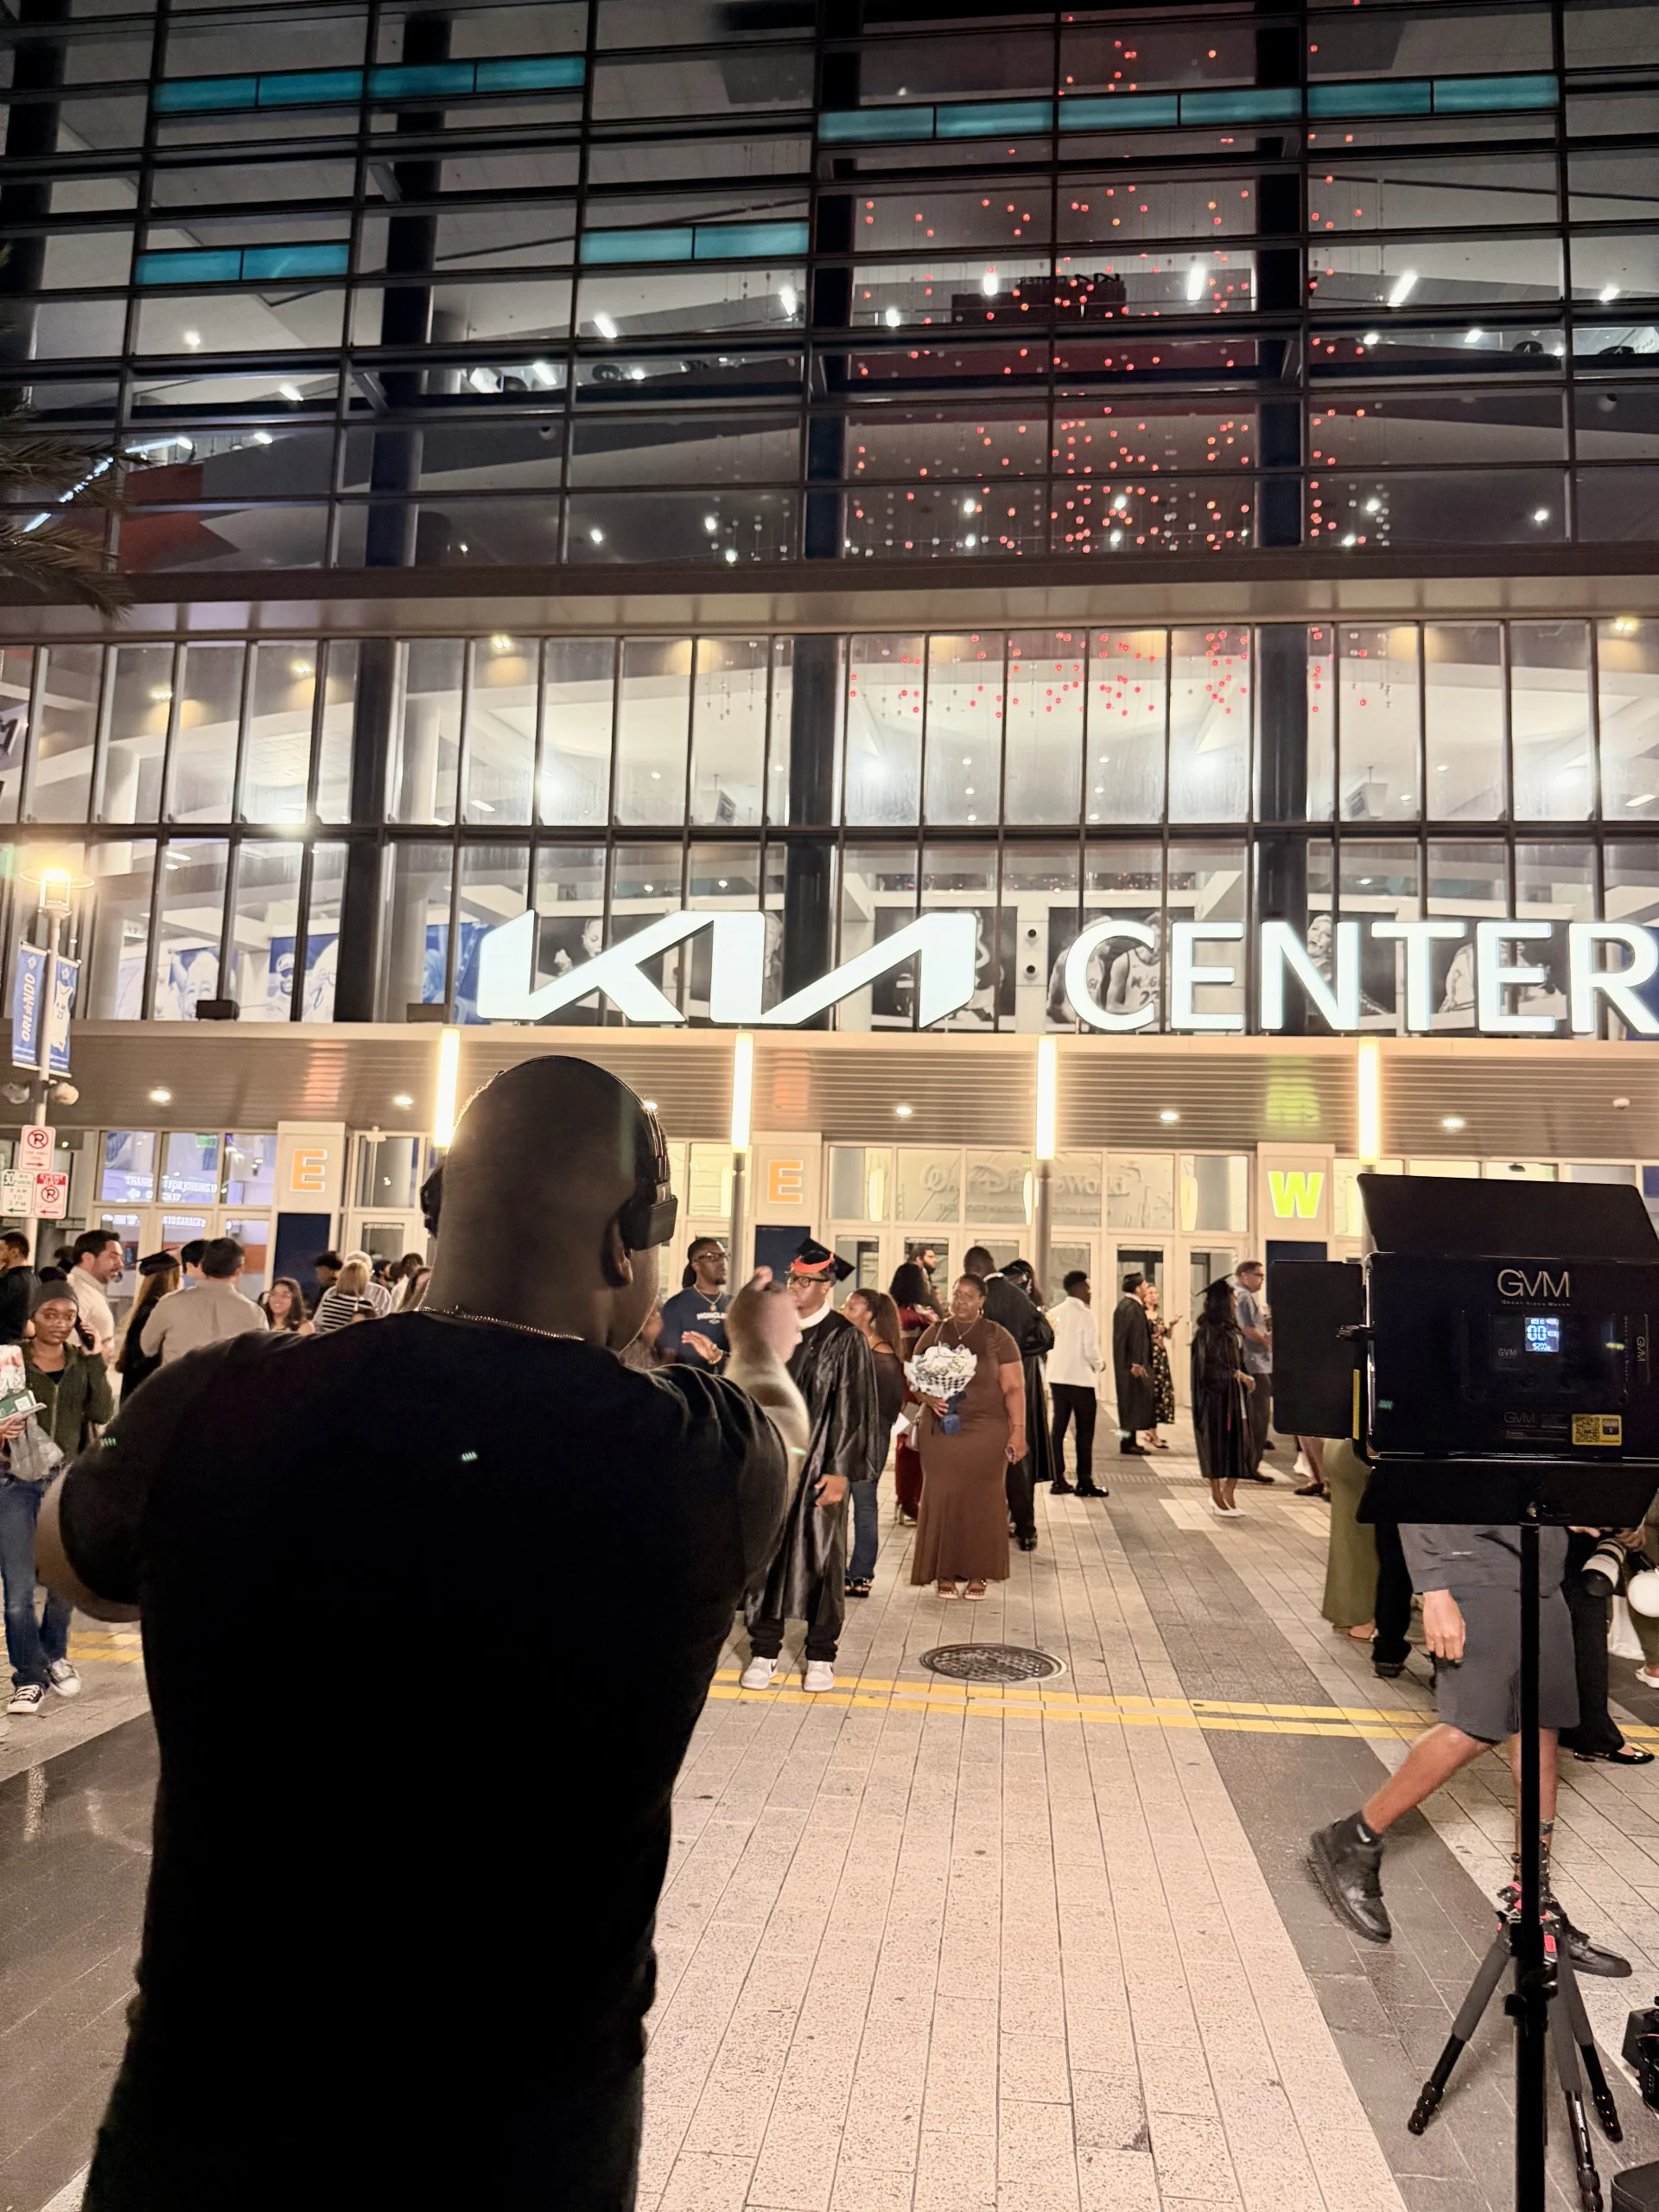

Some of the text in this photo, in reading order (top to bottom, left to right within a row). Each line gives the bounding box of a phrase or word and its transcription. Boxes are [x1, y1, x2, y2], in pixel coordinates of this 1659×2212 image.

[1065, 919, 1659, 1033] CENTER
[290, 1148, 327, 1192] E
[767, 1159, 804, 1205] E
[1268, 1171, 1325, 1218] W
[1497, 1268, 1570, 1298] GVM
[1497, 1348, 1516, 1357] GVM
[1636, 1336, 1646, 1362] GVM
[1503, 1411, 1535, 1424] GVM
